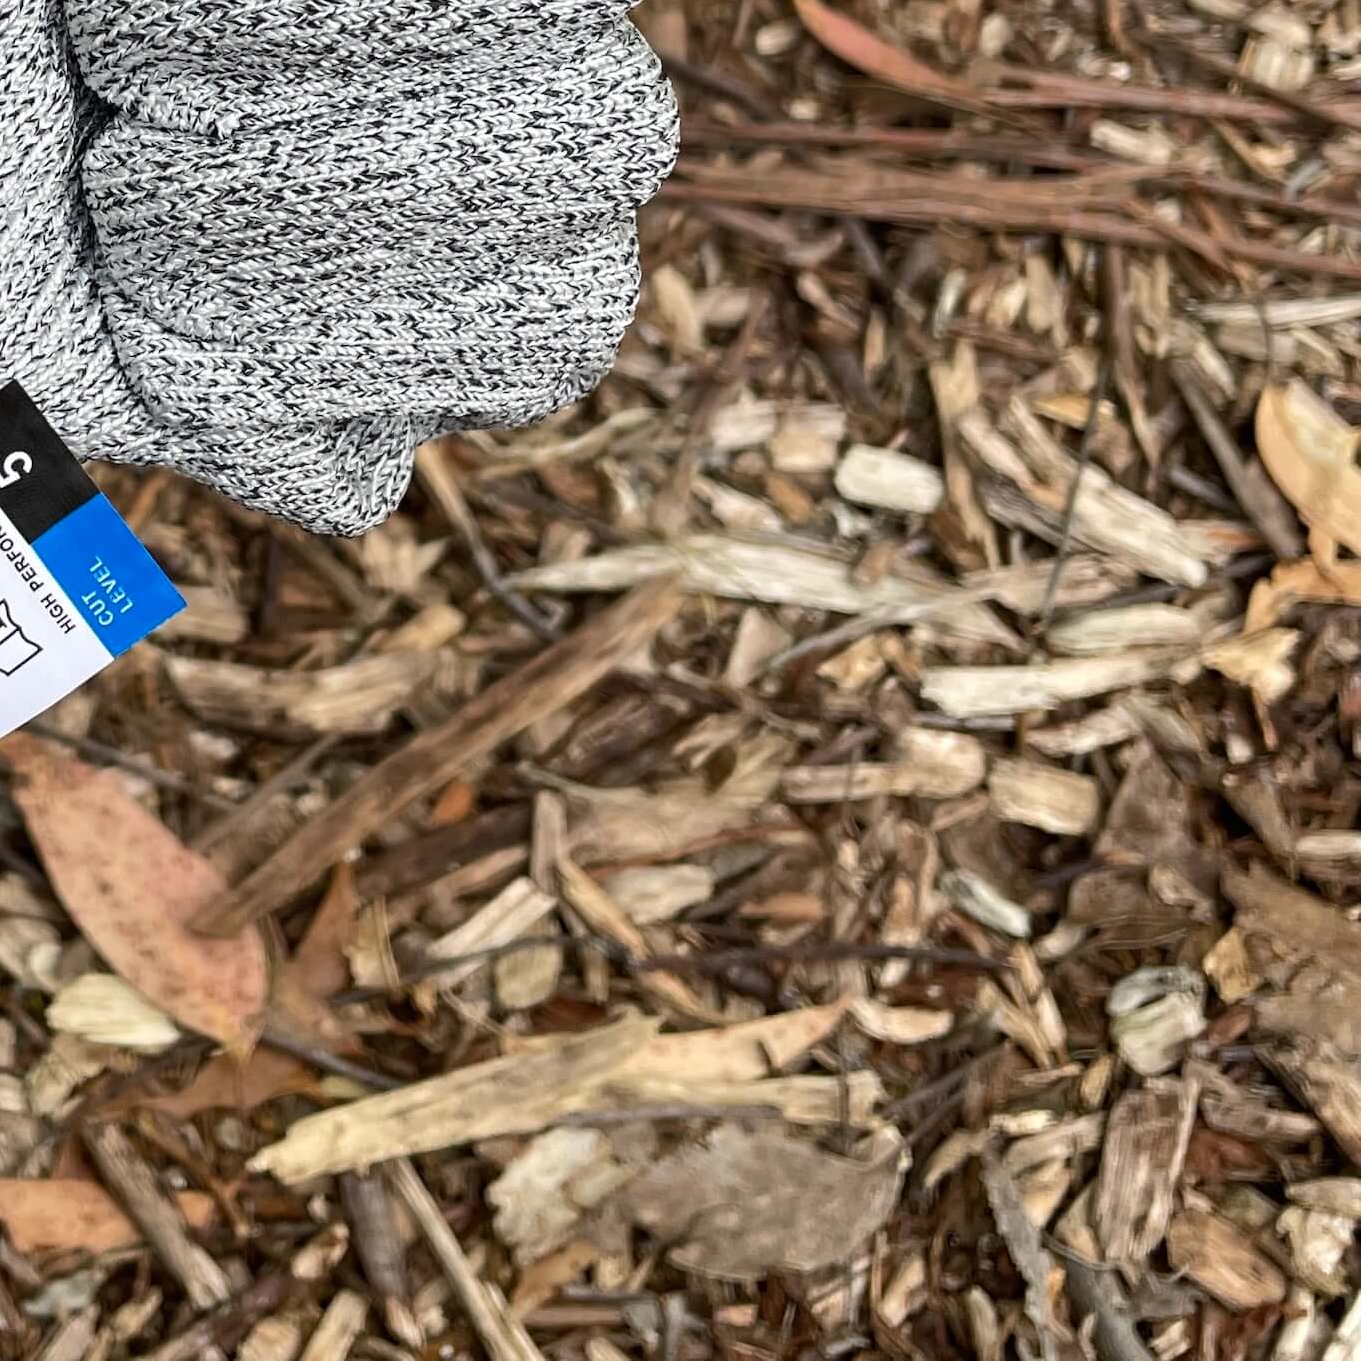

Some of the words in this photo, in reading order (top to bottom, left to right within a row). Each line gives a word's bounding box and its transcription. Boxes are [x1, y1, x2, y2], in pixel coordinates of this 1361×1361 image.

[89, 557, 134, 615] LEVEL
[40, 593, 76, 635] HIGH
[80, 589, 114, 627] CUT
